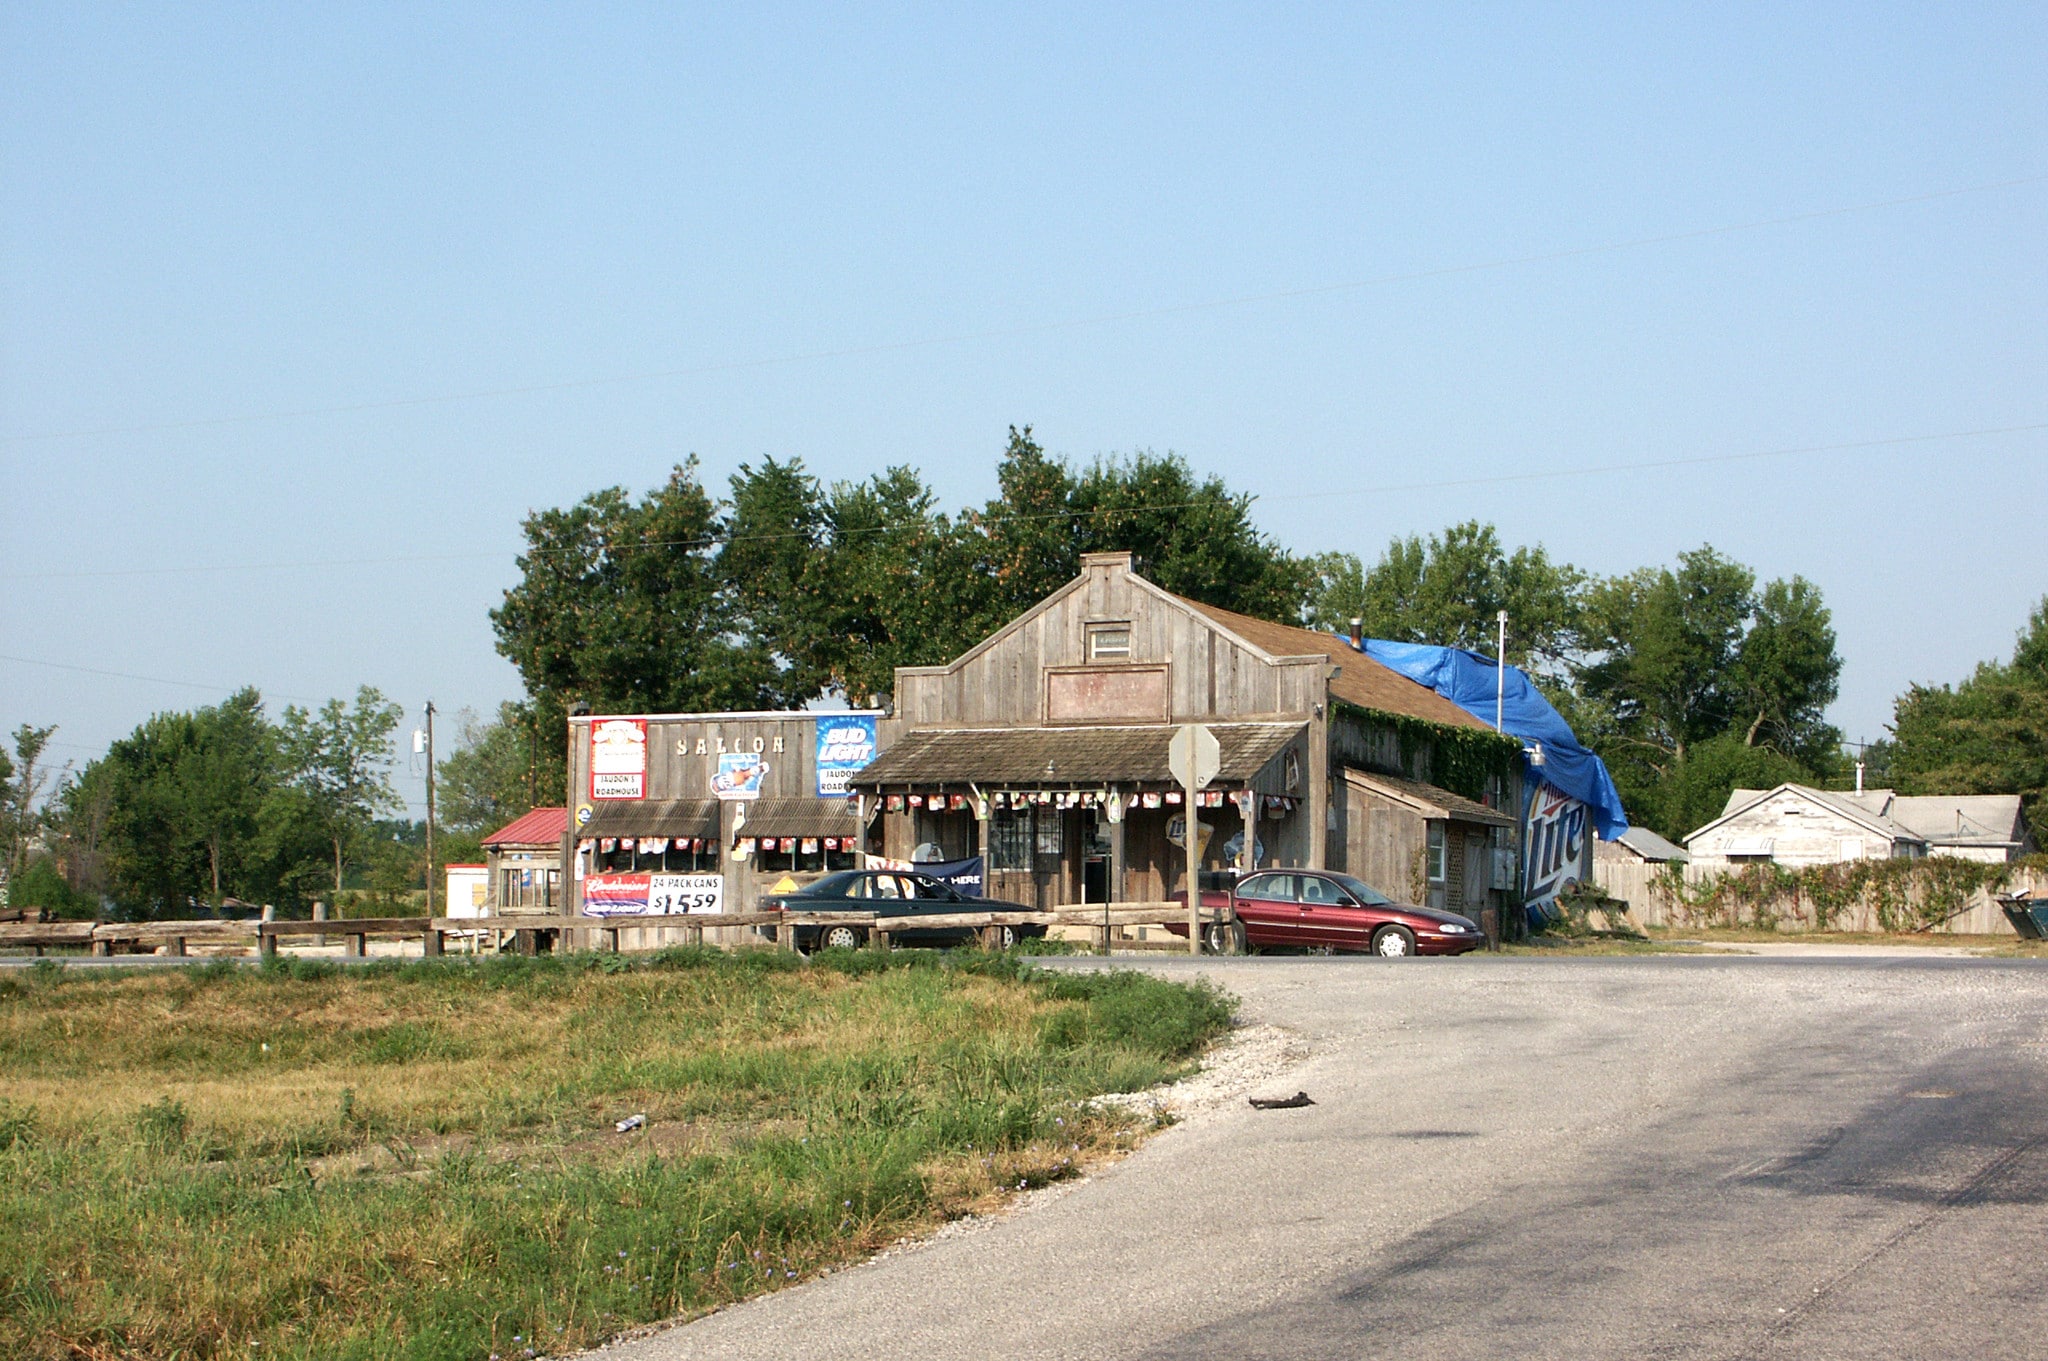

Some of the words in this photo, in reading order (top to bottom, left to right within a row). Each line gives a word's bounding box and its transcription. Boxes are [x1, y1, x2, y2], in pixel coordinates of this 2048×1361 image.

[827, 728, 867, 745] BUD
[818, 744, 873, 762] LIGHT
[596, 788, 639, 796] ROADHOUSE
[586, 876, 649, 892] Budweiser
[653, 878, 664, 888] 24
[668, 878, 692, 888] PACK
[694, 878, 718, 888] CANS
[951, 875, 980, 885] HERE
